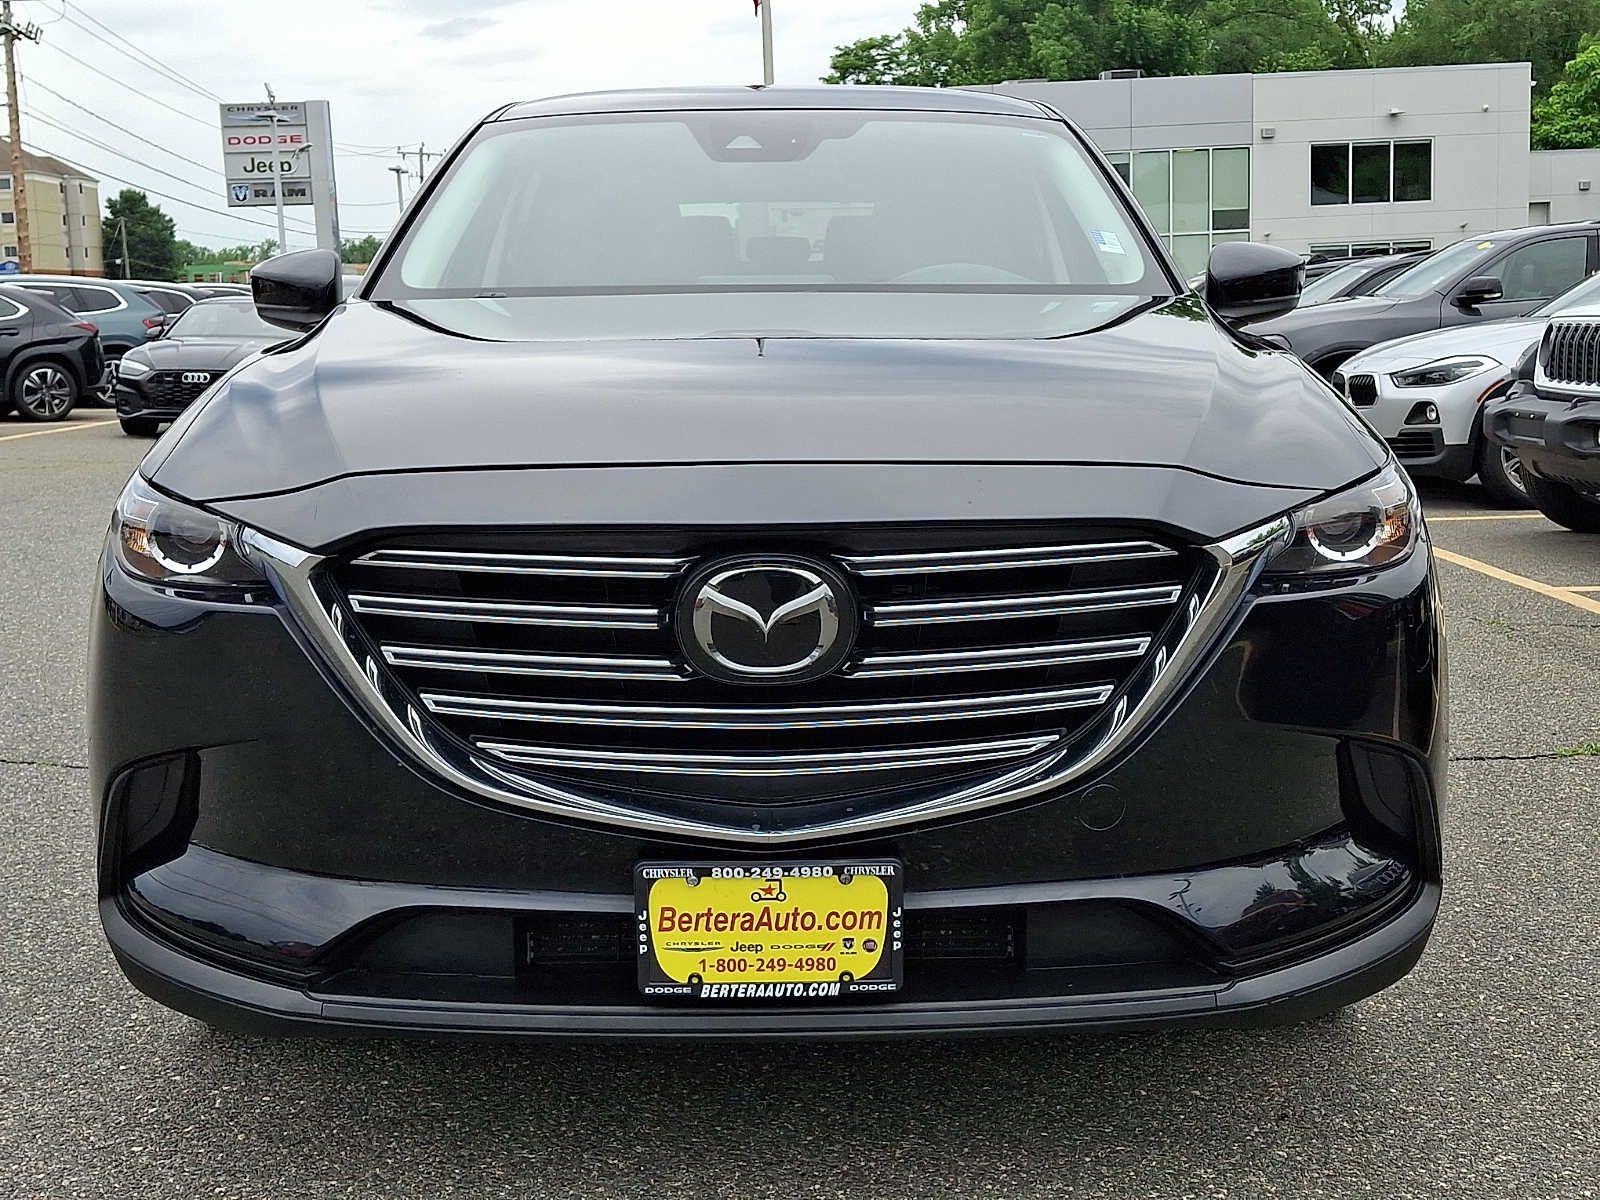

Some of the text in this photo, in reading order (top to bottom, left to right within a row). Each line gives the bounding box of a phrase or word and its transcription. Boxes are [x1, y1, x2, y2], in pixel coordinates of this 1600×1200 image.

[228, 135, 302, 145] DODGE
[643, 869, 694, 878] CHRYSLER
[711, 867, 833, 878] 800-249-4980
[844, 866, 895, 876] CHRYSLER
[658, 906, 882, 932] BerteraAuto.com
[638, 910, 648, 954] Jeep
[892, 907, 902, 951] Jeep
[730, 941, 763, 954] Jeep
[699, 957, 837, 973] 1-800-249-4980
[701, 983, 840, 997] BERTERAAUTO.COM
